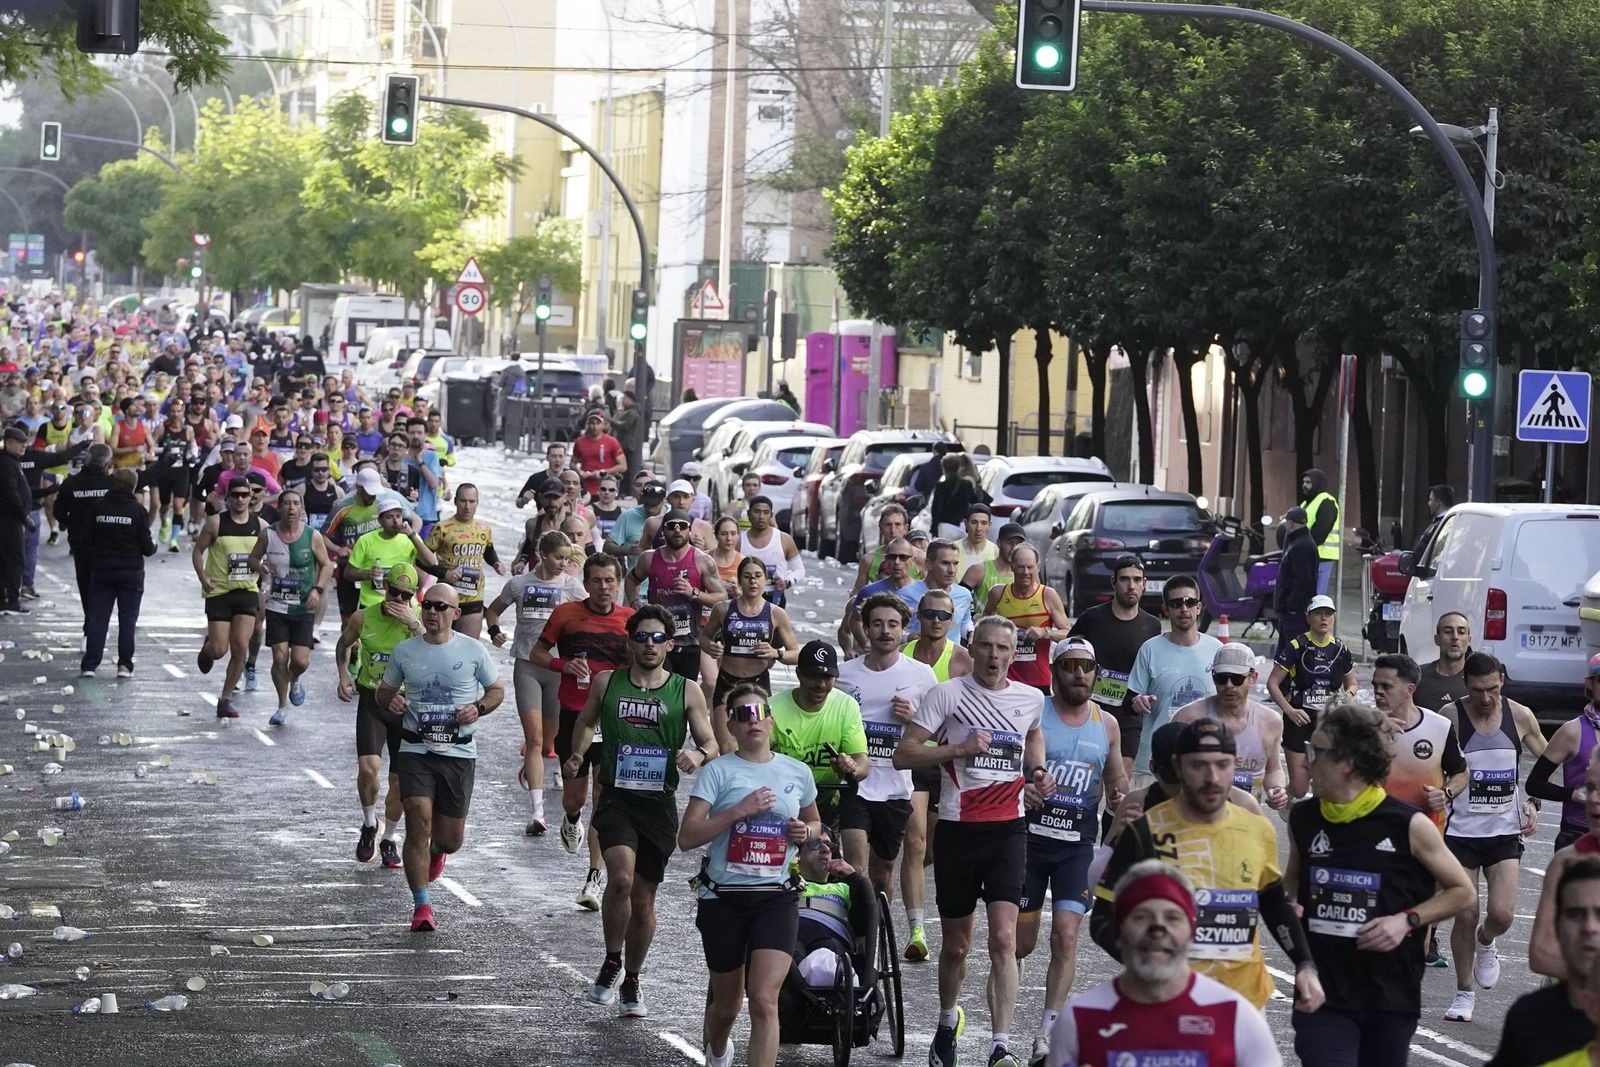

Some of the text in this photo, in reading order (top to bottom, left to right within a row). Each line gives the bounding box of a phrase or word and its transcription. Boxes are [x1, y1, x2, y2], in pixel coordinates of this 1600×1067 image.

[462, 294, 480, 305] 30
[20, 461, 35, 469] TEER
[96, 515, 133, 525] VOLUNTEER
[1529, 634, 1582, 648] 9177 MFY
[1101, 686, 1124, 699] OÑATZ
[618, 701, 658, 722] GAMA
[869, 724, 897, 734] ZURICH
[868, 737, 884, 746] 4152
[993, 733, 1018, 743] URICH
[634, 747, 662, 756] ZURICH
[634, 760, 649, 768] 5843
[974, 756, 1014, 771] MARTEL
[619, 768, 662, 780] AURÉLIEN
[1234, 774, 1247, 783] ICH
[1486, 772, 1512, 780] ZURICH
[1053, 793, 1082, 805] ZURICH
[1469, 795, 1488, 804] JUAN
[1051, 807, 1068, 817] 4777
[1040, 814, 1073, 830] EDGAR
[749, 825, 782, 835] ZURICH
[749, 841, 767, 850] 1396
[742, 851, 772, 864] JANA
[1334, 872, 1373, 886] ZURICH
[1215, 893, 1253, 904] ZURICH
[1317, 903, 1368, 923] CARLOS
[1194, 926, 1251, 943] SZYMON
